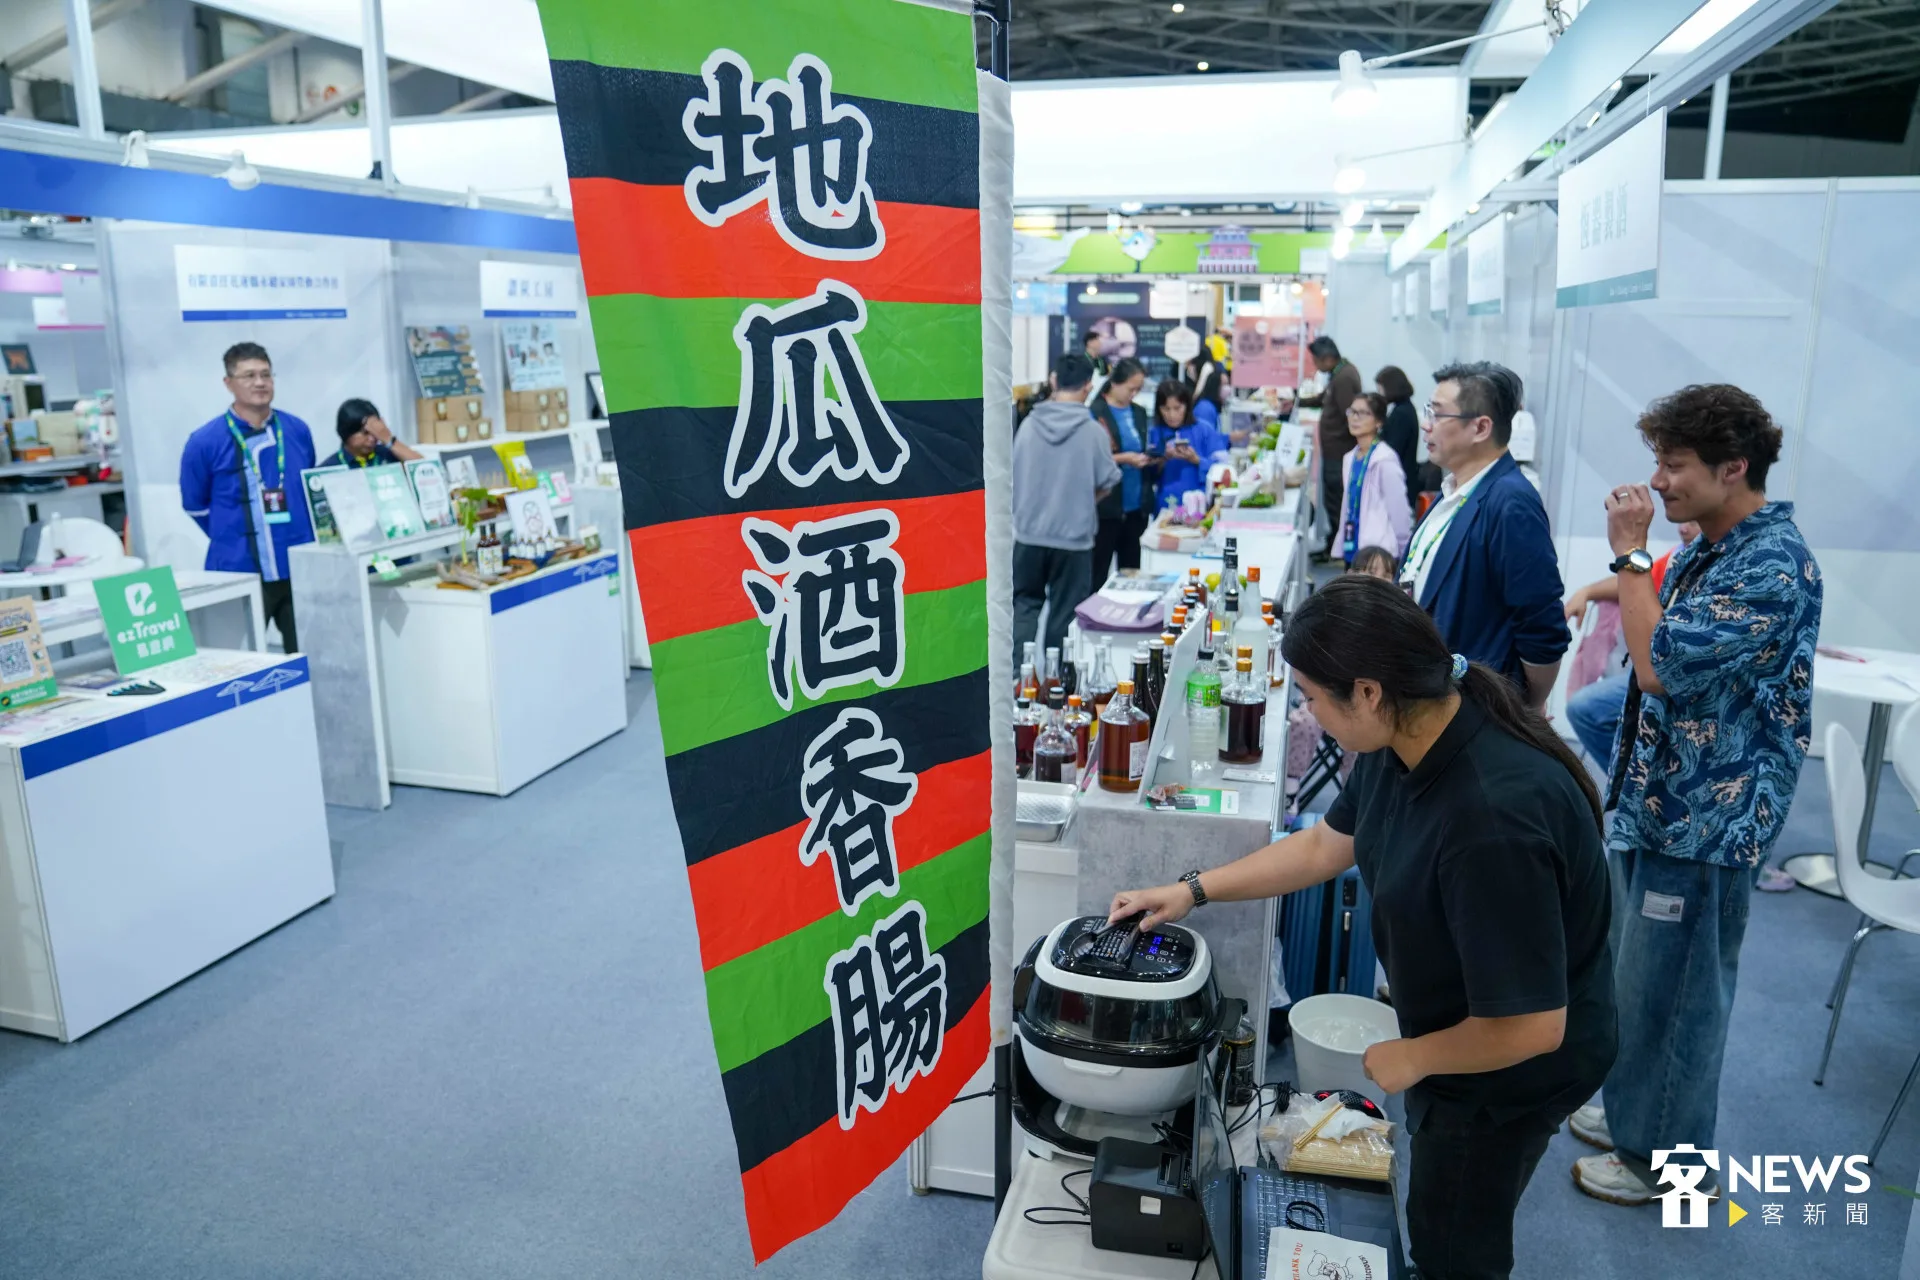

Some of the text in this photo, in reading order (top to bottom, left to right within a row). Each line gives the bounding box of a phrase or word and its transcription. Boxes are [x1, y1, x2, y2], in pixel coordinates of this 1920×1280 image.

[117, 613, 181, 643] ezTravel
[682, 48, 949, 1130] 地瓜酒香腸
